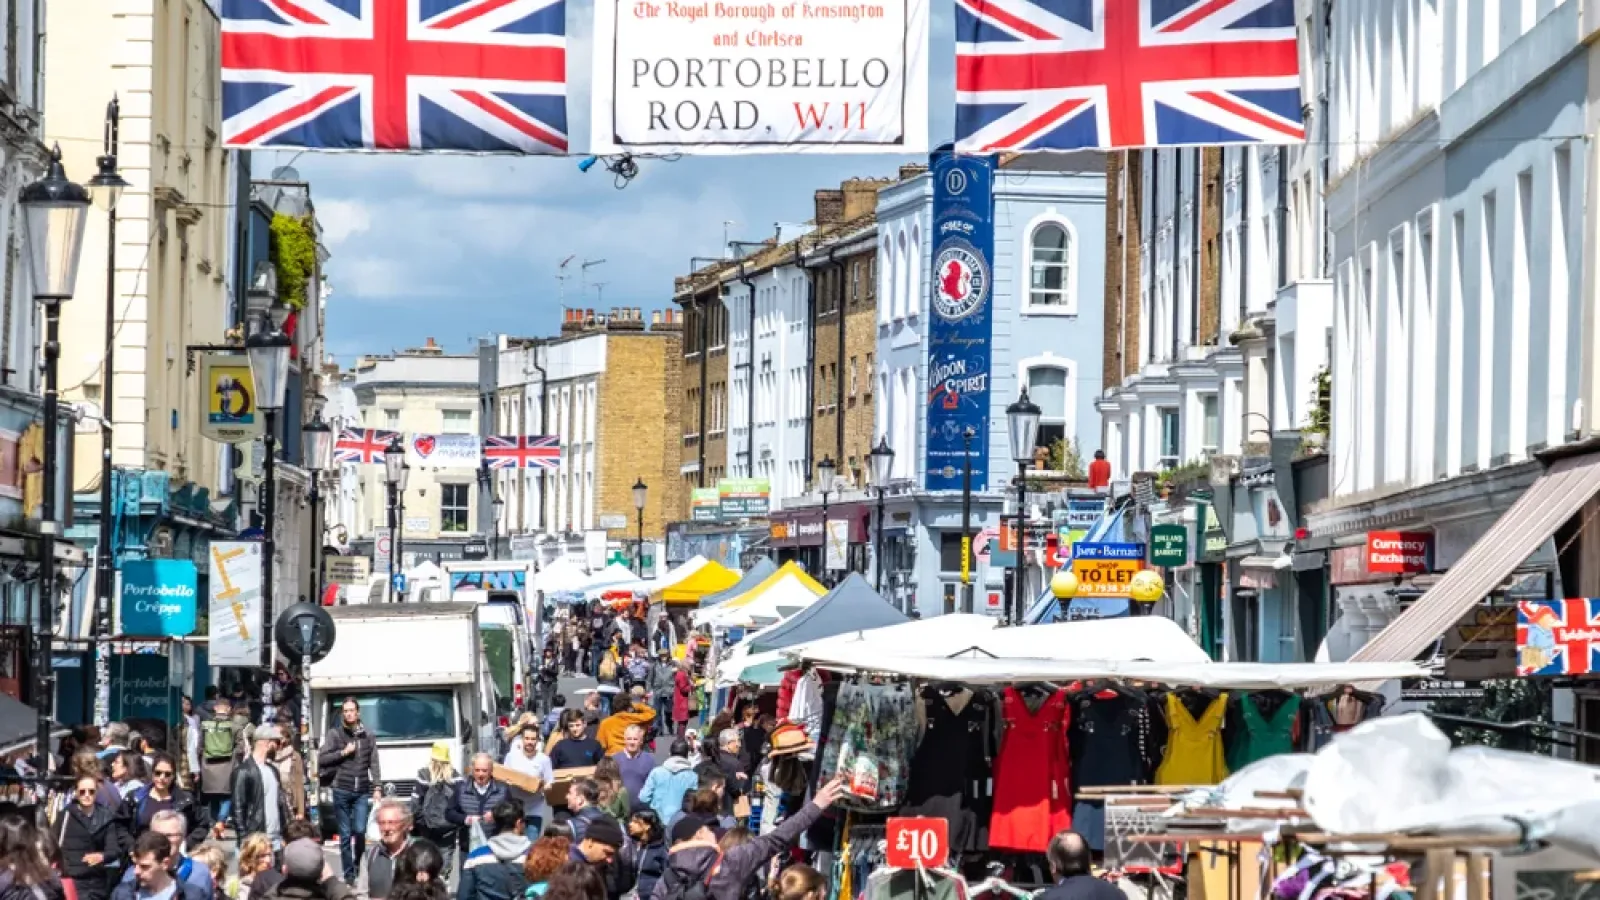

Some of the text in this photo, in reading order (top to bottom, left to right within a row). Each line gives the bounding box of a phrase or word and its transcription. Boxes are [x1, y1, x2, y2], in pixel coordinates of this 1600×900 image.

[634, 1, 884, 23] The Royal Borough of Kensington
[713, 29, 804, 48] and Chelsea
[632, 57, 889, 89] PORTOBELLO
[648, 100, 867, 134] ROAD, W.11
[1154, 534, 1184, 543] HOLLAND
[1372, 538, 1425, 552] Currency
[1103, 545, 1144, 557] Barnard
[1154, 549, 1183, 557] BARRETT
[1096, 562, 1119, 570] SHOP
[1371, 553, 1426, 567] Exchange
[1080, 569, 1134, 583] TO LET
[124, 584, 194, 597] Portobello
[135, 601, 181, 618] Crêpes
[896, 829, 938, 860] £10
